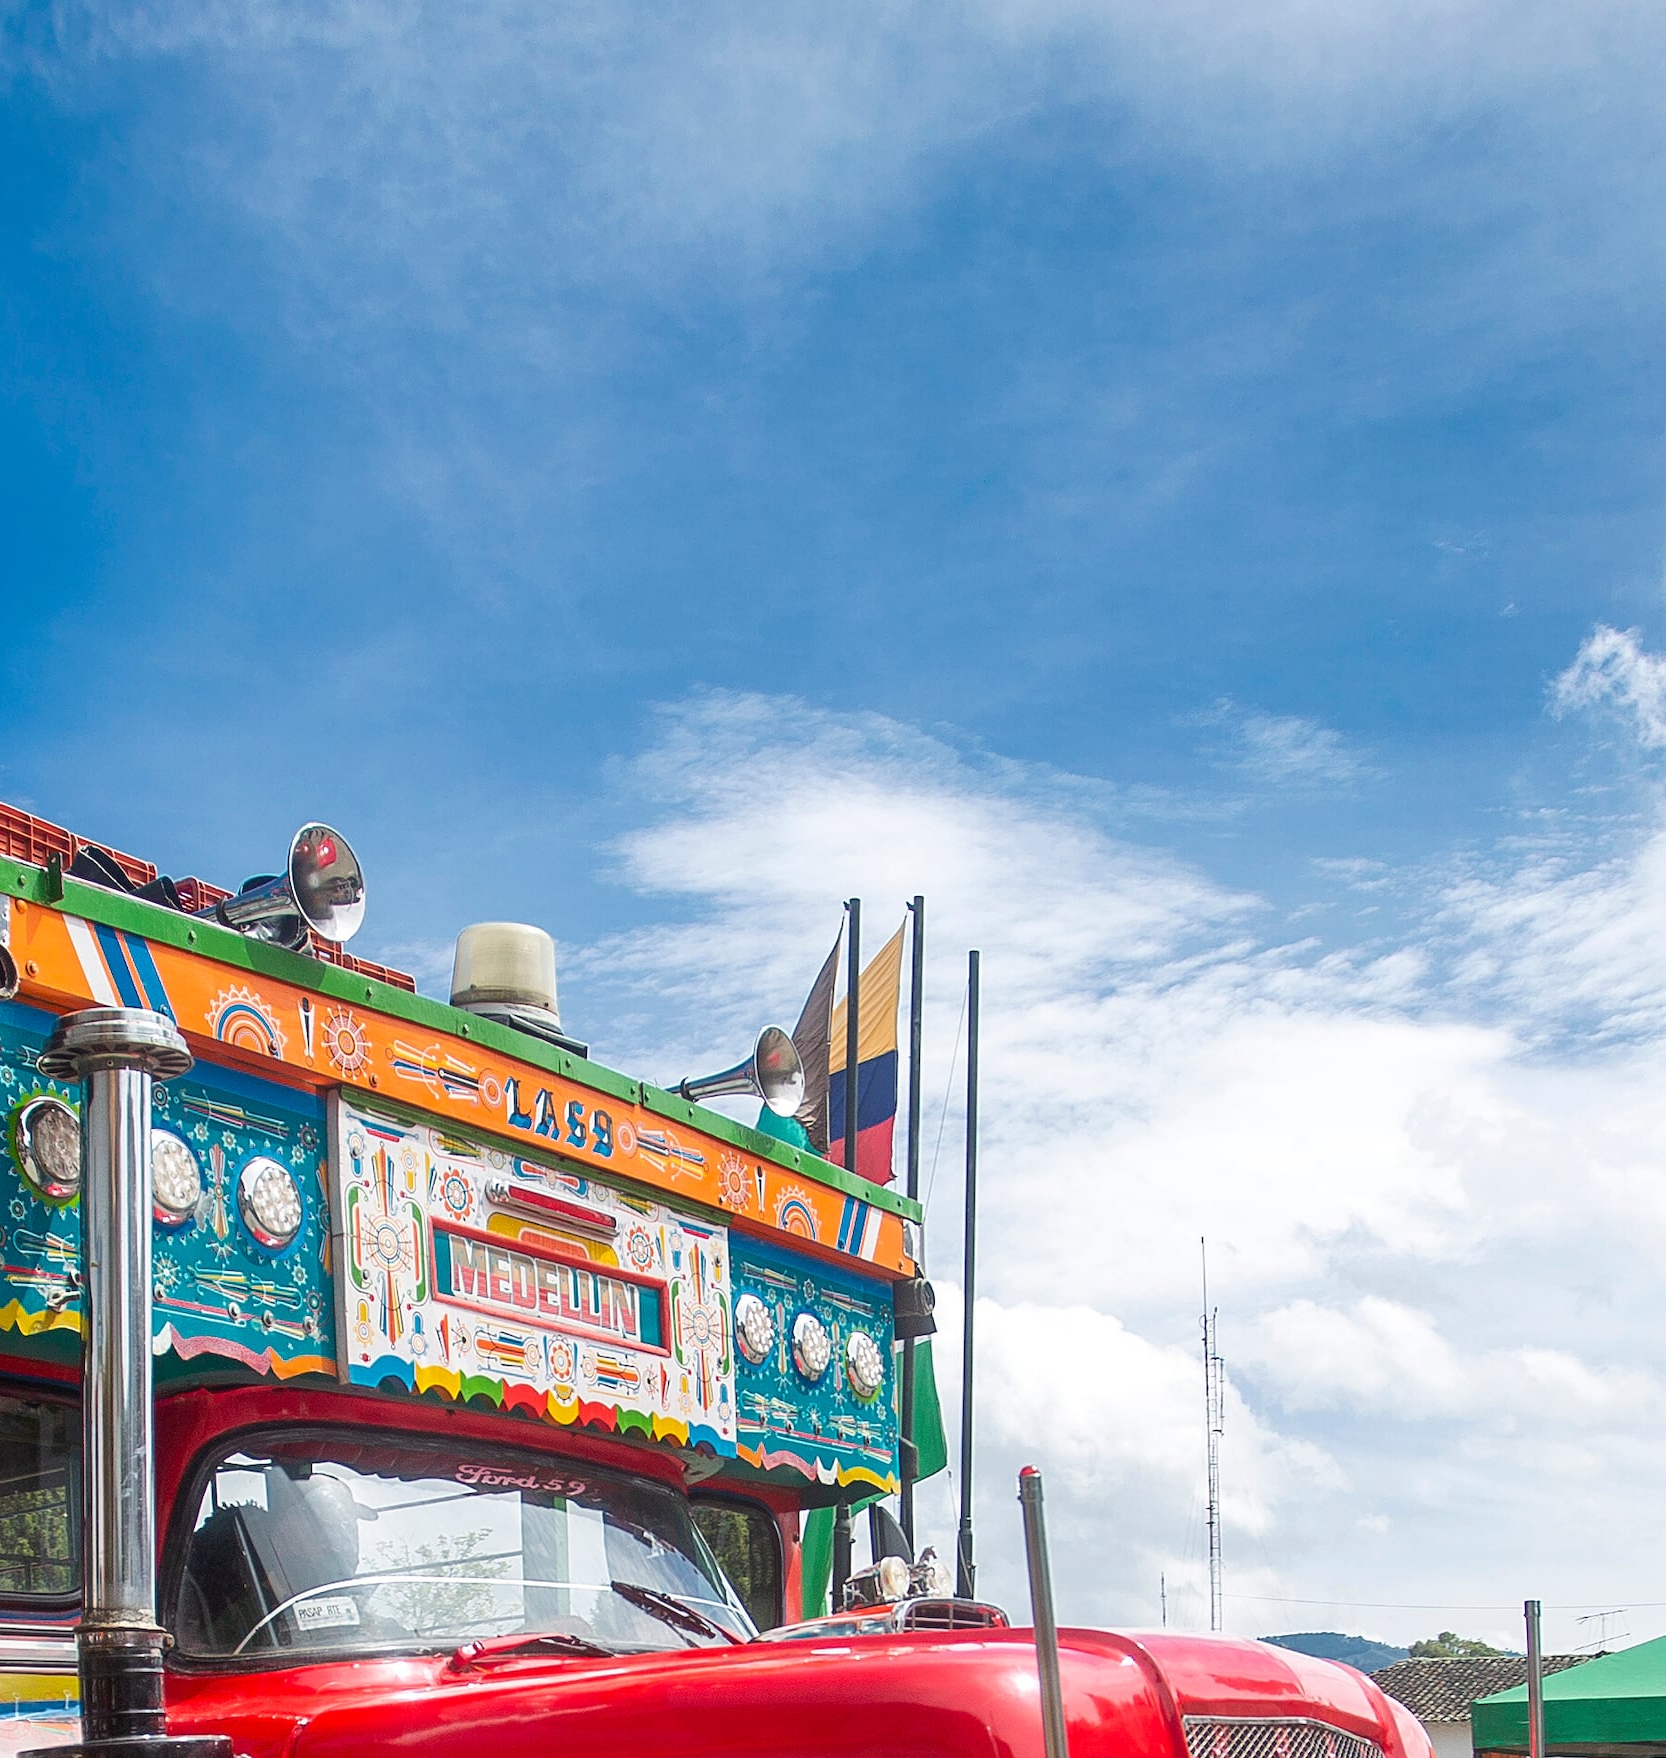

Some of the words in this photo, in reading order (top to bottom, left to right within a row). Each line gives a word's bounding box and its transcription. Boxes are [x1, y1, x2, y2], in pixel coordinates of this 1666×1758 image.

[449, 1233, 641, 1342] MEDELLIN
[455, 1464, 540, 1489] Ford
[543, 1478, 586, 1496] 59
[298, 1605, 342, 1619] PASAPRTE
